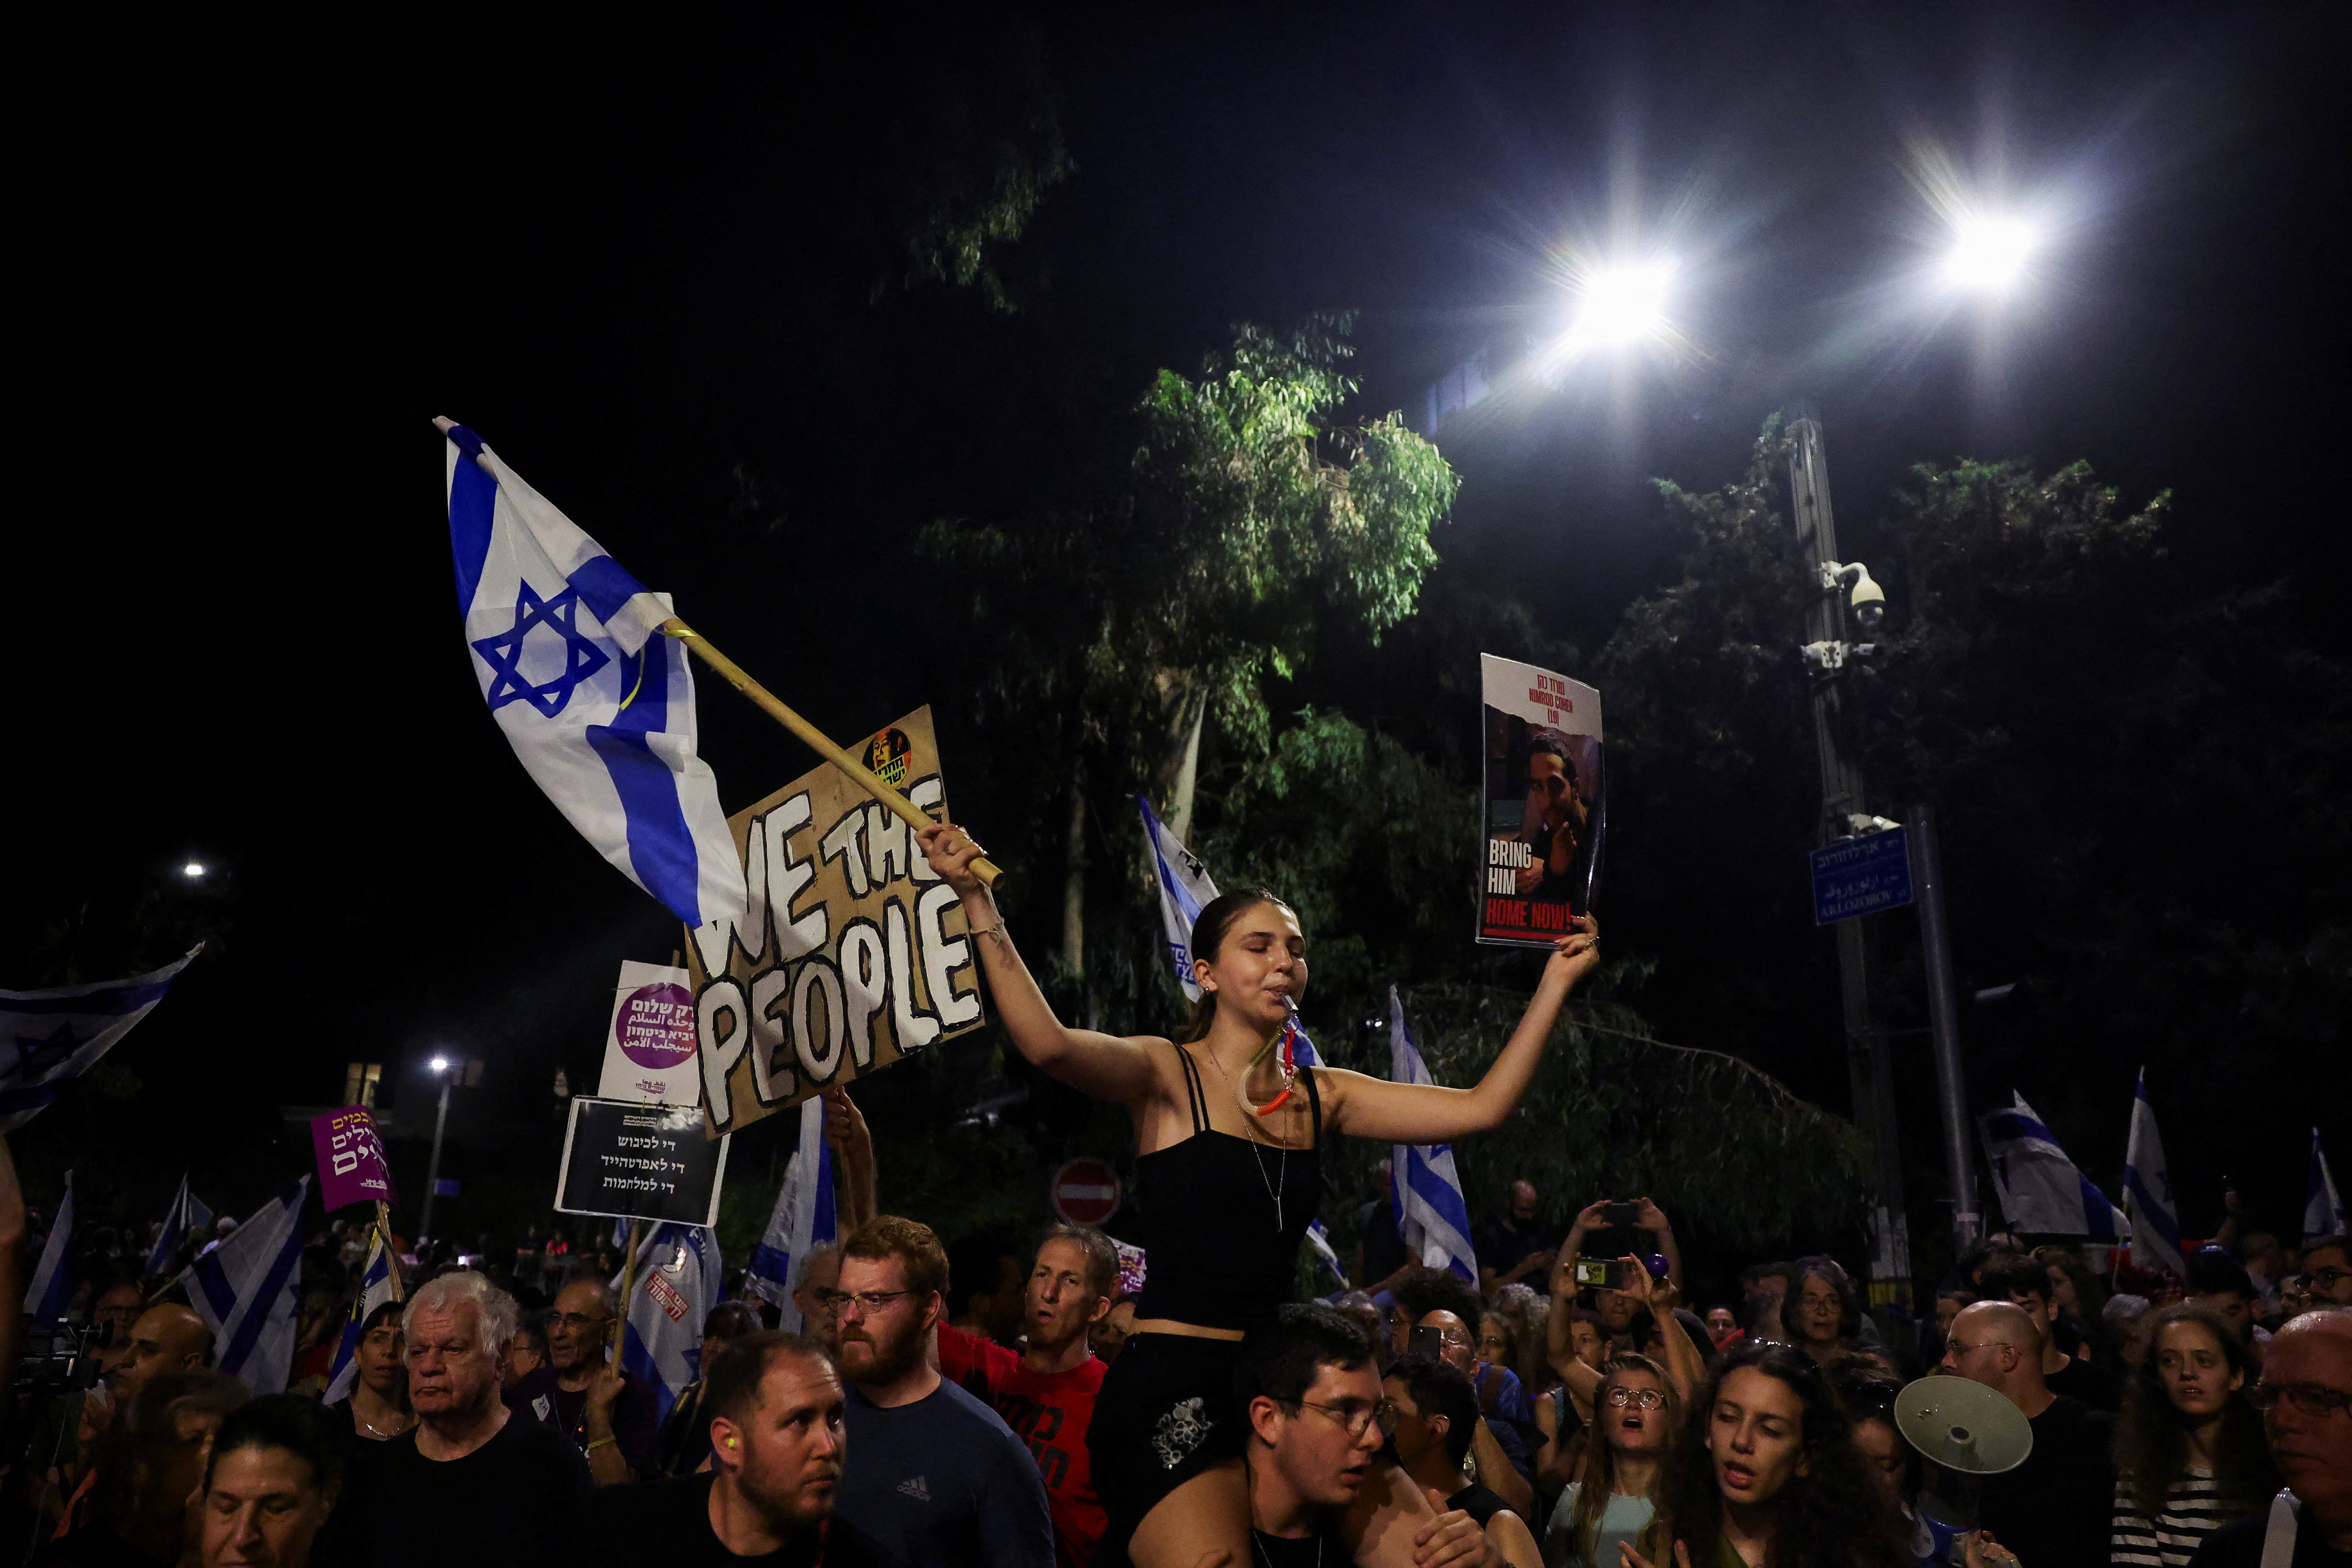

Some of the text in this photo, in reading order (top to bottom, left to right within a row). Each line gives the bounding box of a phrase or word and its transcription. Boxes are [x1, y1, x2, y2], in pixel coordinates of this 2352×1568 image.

[1537, 674, 1547, 689] כהן
[1529, 688, 1573, 714] NIMROD COHEN
[874, 756, 904, 776] מחרי
[818, 775, 943, 899] THE
[1489, 839, 1532, 868] BRING
[1488, 867, 1516, 895] HIM
[1486, 898, 1572, 931] HOME NOW!
[632, 999, 674, 1014] שלום
[693, 883, 982, 1131] PEOPLE
[628, 1013, 665, 1025] السلام
[626, 1026, 694, 1041] יביא ביטחון
[623, 1036, 692, 1053] سيجلب الأمن
[618, 1136, 676, 1151] די לכיבוש
[601, 1155, 685, 1173] די לאפרטהייד
[603, 1176, 674, 1194] די למלחמות
